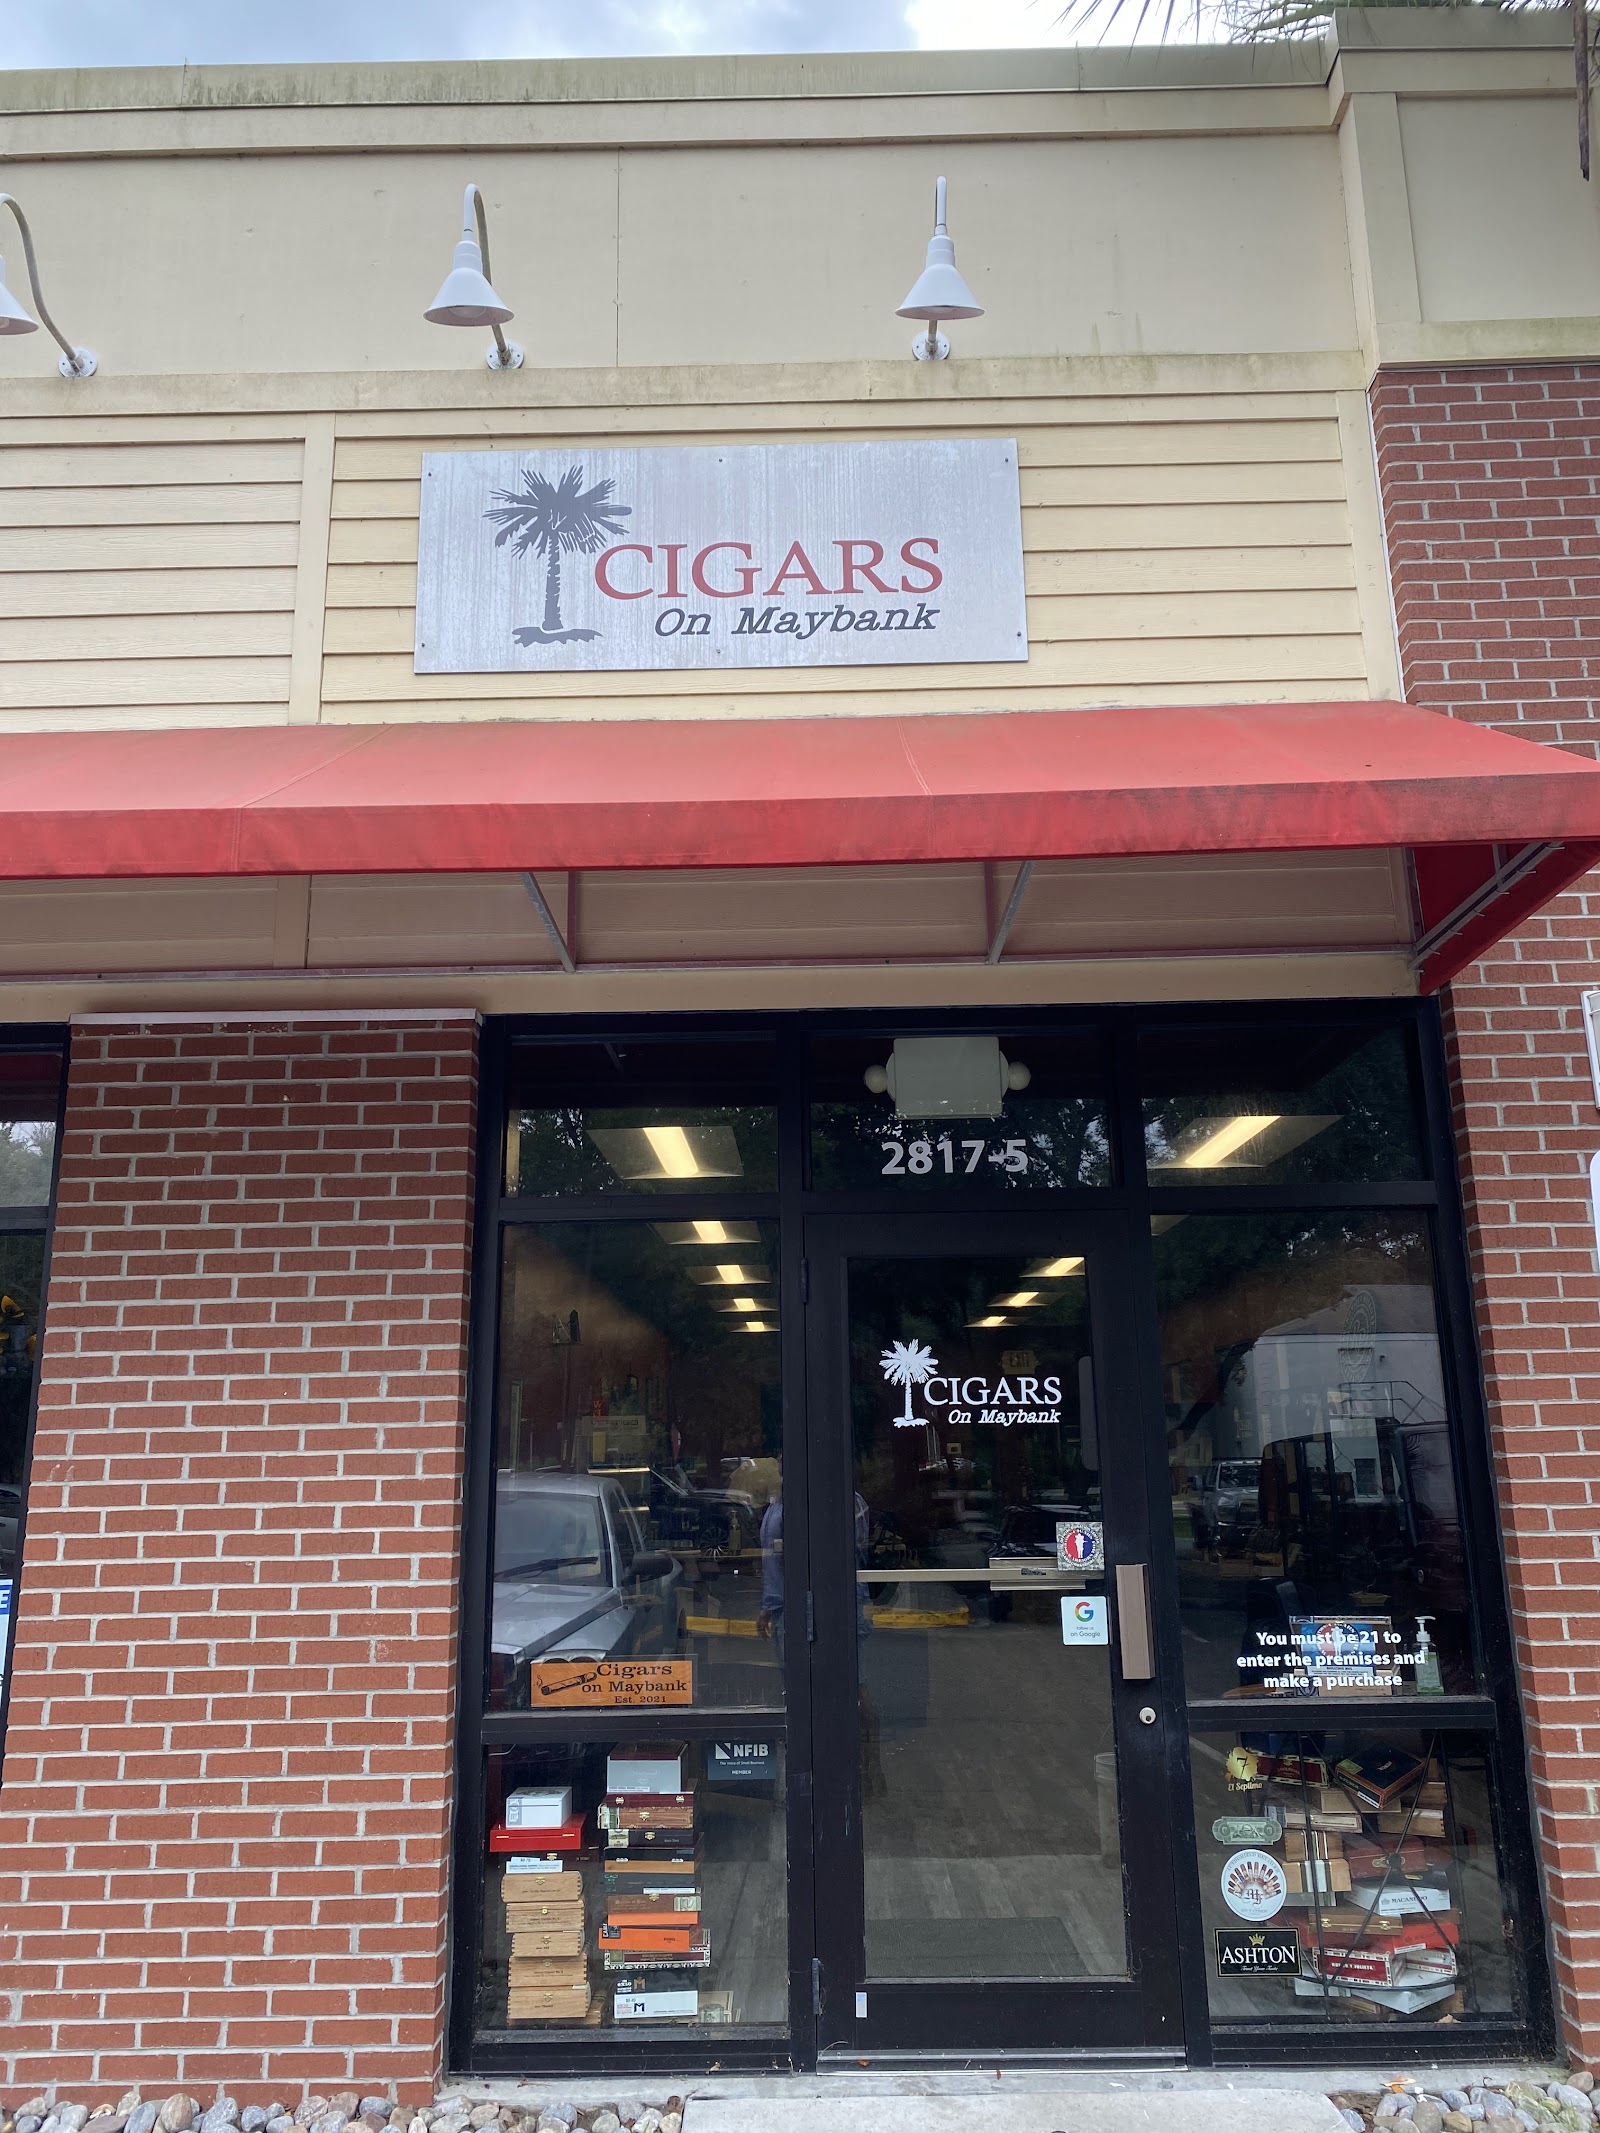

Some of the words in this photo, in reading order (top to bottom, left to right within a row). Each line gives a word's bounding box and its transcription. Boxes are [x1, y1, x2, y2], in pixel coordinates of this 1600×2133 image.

[594, 537, 943, 600] CIGARS
[655, 608, 711, 636] On
[732, 603, 942, 640] Maybank
[881, 1139, 1029, 1175] 2817-5
[924, 1376, 1063, 1406] CIGARS
[948, 1410, 971, 1424] On
[978, 1409, 1062, 1427] Maybank
[1256, 1632, 1287, 1646] You
[1291, 1631, 1332, 1645] must
[1360, 1630, 1379, 1644] 21
[1383, 1631, 1401, 1644] to
[1236, 1654, 1281, 1668] enter
[1284, 1652, 1312, 1667] the
[1315, 1651, 1391, 1669] premises
[1394, 1650, 1425, 1665] and
[596, 1663, 672, 1679] Cigars
[582, 1684, 603, 1693] on
[609, 1680, 687, 1695] Maybank
[1264, 1673, 1310, 1688] make
[1313, 1677, 1322, 1688] a
[1326, 1673, 1403, 1690] purchase
[614, 1696, 635, 1704] Est.
[640, 1696, 666, 1704] 2021
[733, 1744, 769, 1757] NFIB
[1228, 1782, 1235, 1792] El
[1236, 1782, 1262, 1792] Septimo
[1221, 1945, 1296, 1964] ASHTON
